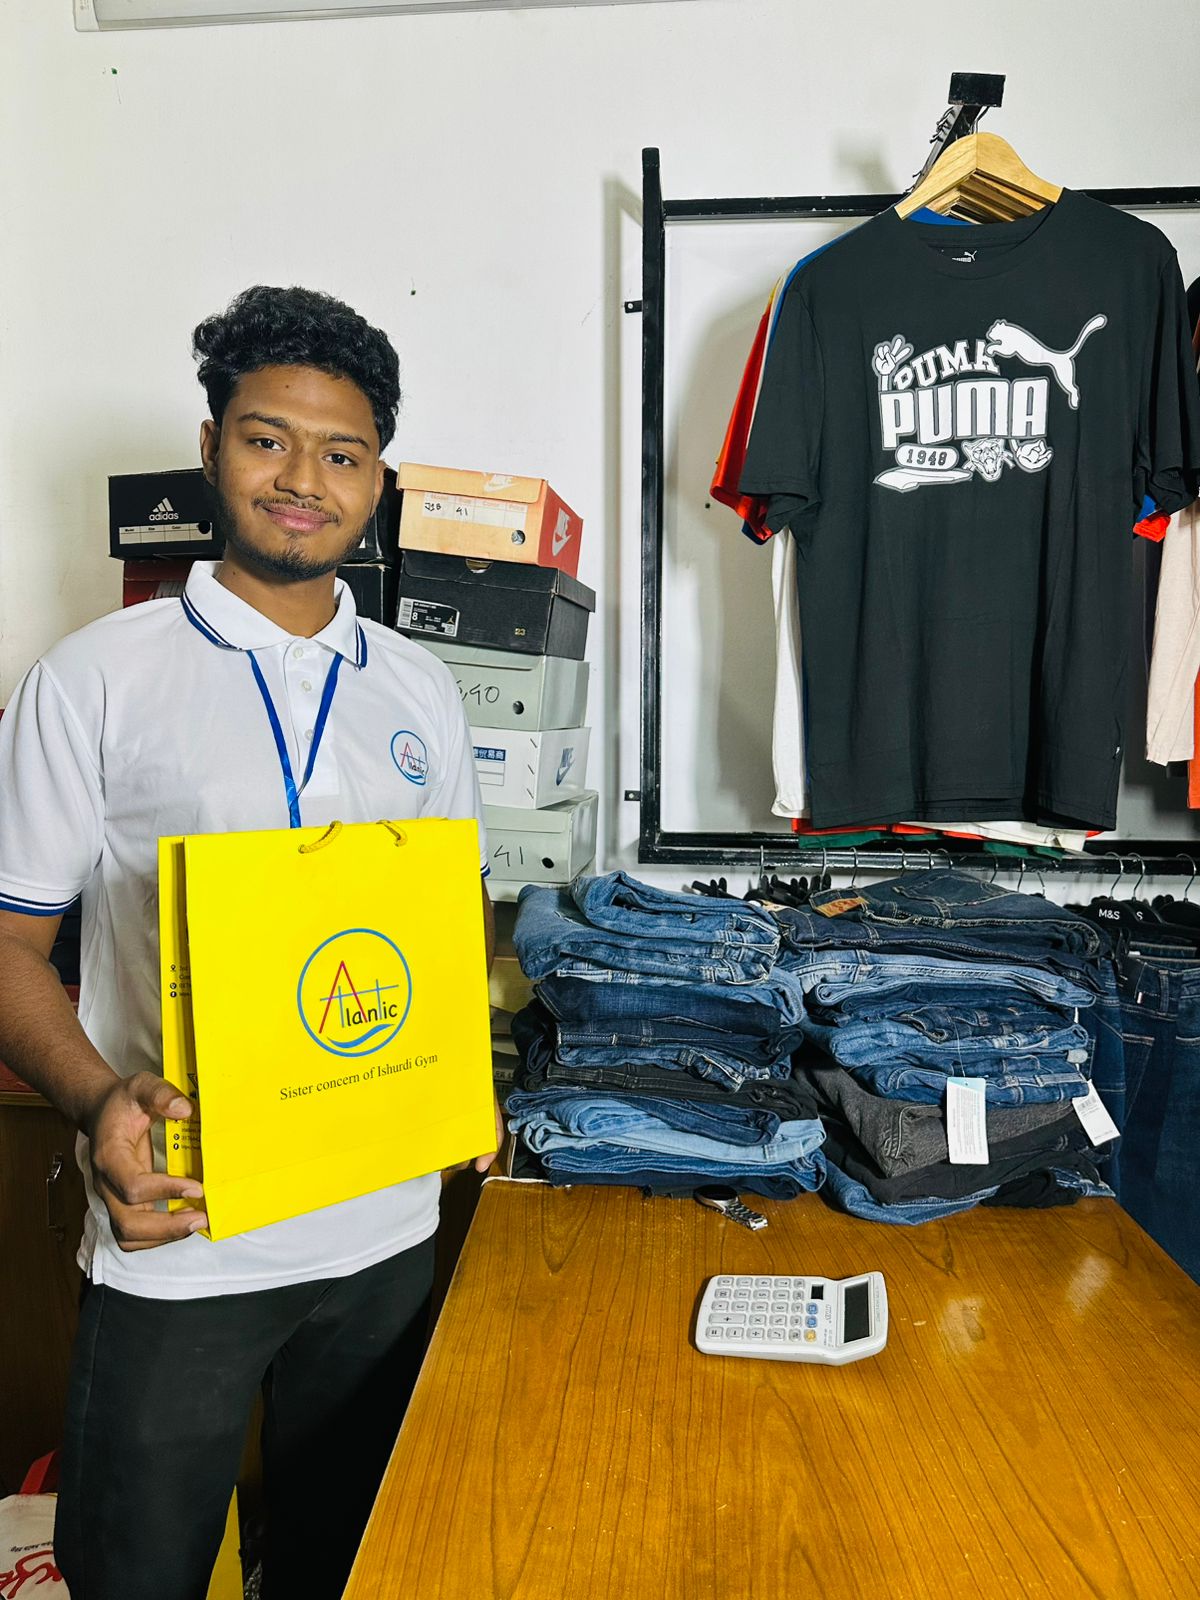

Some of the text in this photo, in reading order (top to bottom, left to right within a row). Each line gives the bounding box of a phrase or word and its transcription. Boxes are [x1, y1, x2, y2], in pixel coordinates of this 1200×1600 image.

[893, 339, 1001, 390] PUMA
[880, 377, 1048, 450] PUMA
[906, 448, 948, 466] 1948
[148, 511, 180, 521] adidas
[411, 611, 418, 621] 8
[515, 628, 526, 636] 23
[1099, 908, 1120, 920] M&S
[317, 960, 399, 1034] Atlantic
[280, 1054, 438, 1101] Sister concern of Ishurdi Gym
